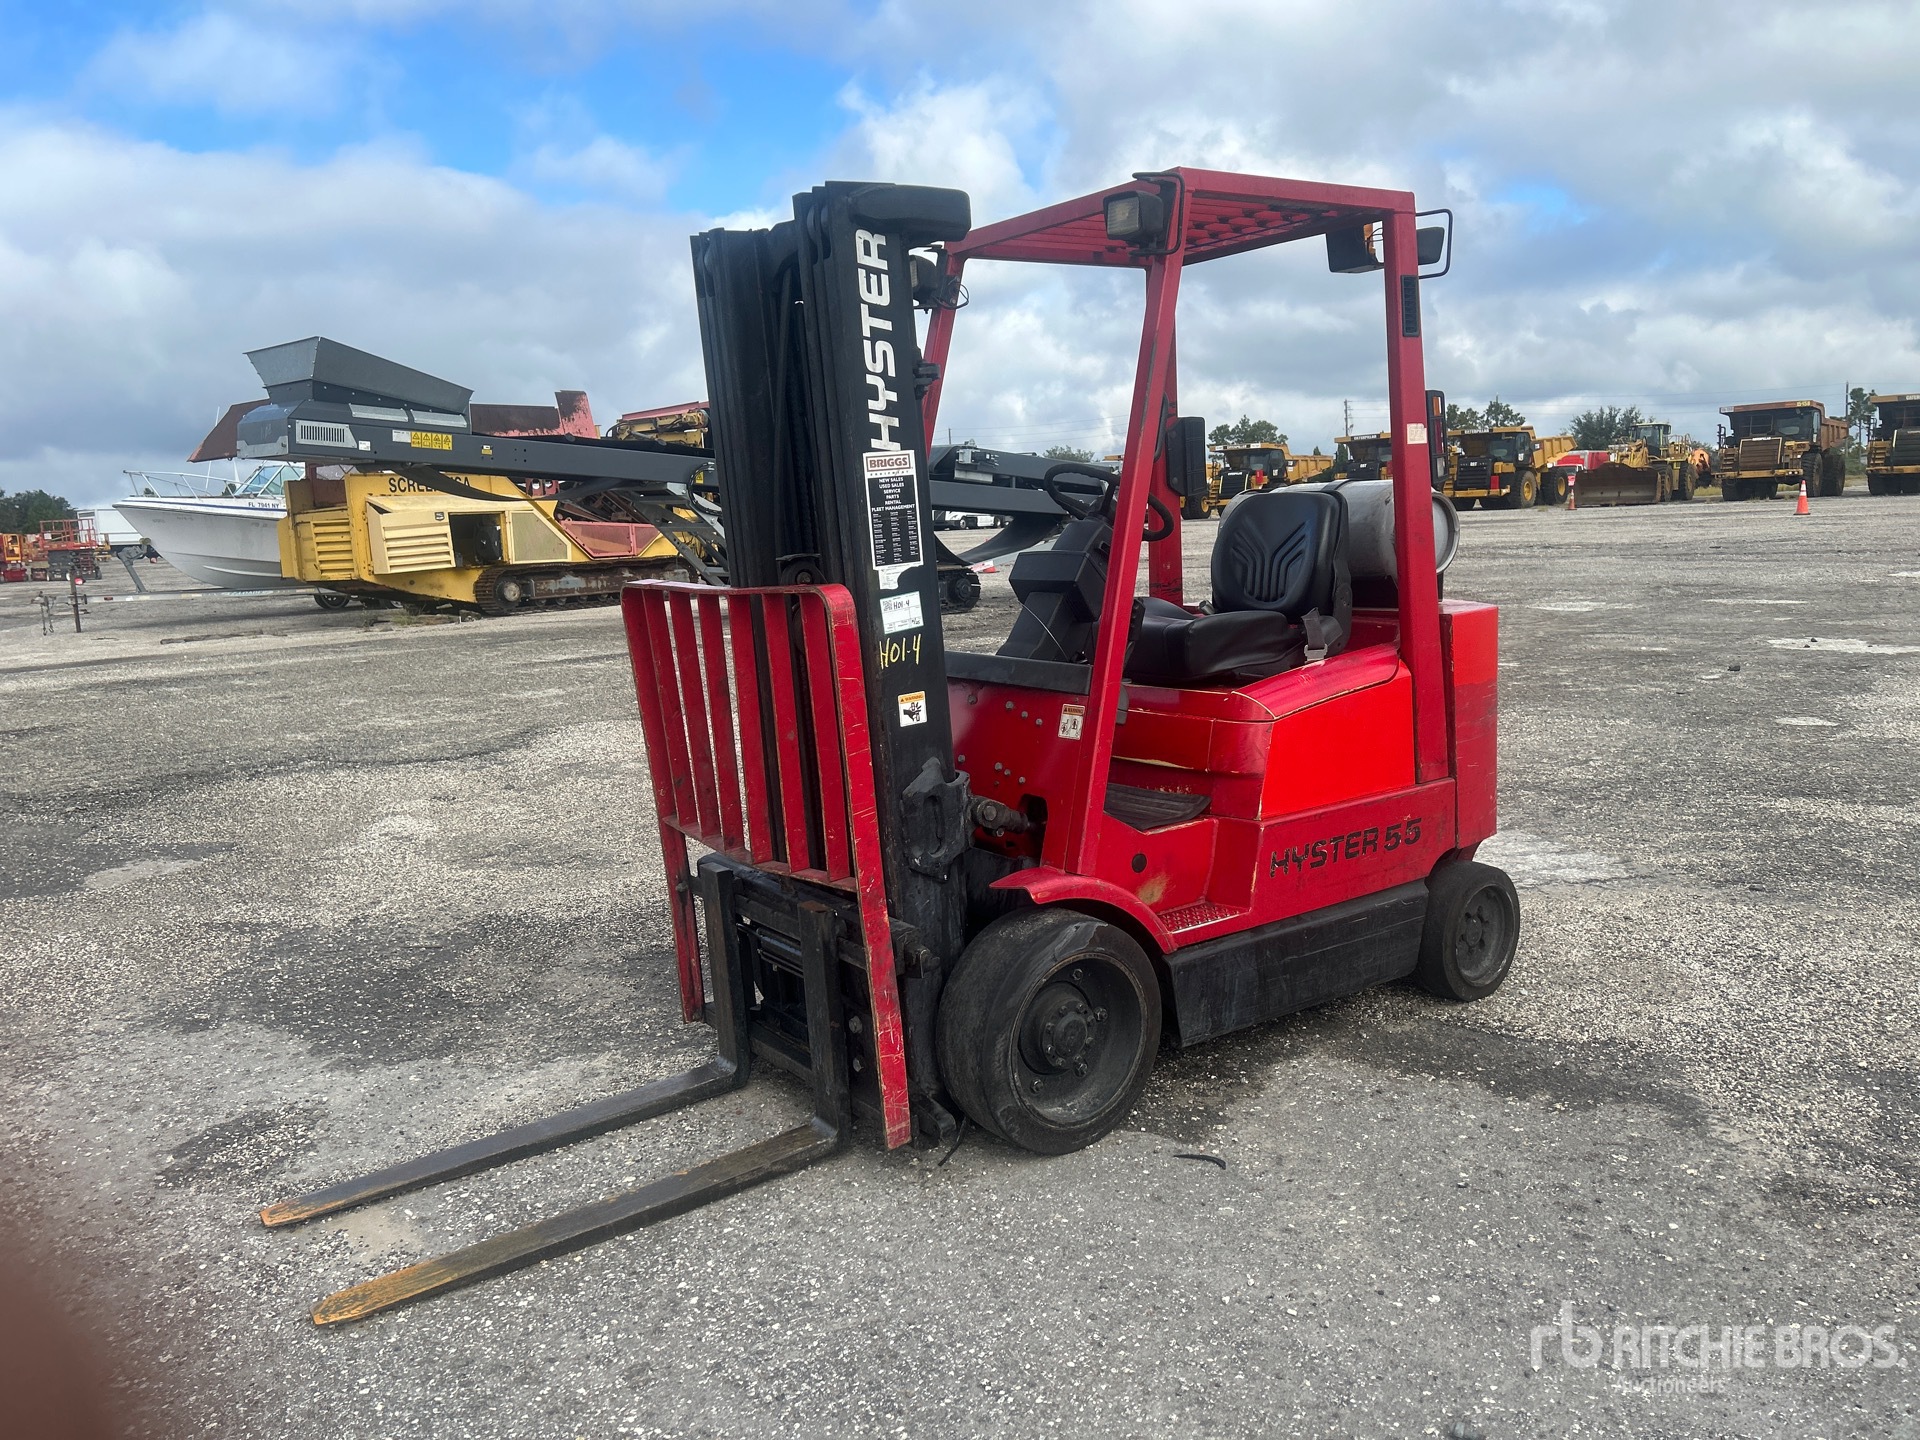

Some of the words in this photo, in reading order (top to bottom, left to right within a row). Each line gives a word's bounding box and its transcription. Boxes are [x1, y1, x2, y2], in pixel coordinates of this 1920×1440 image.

[855, 228, 902, 451] HYSTER
[869, 457, 908, 468] BRIGGS
[1269, 826, 1379, 879] HYSTER
[1383, 817, 1422, 852] 55
